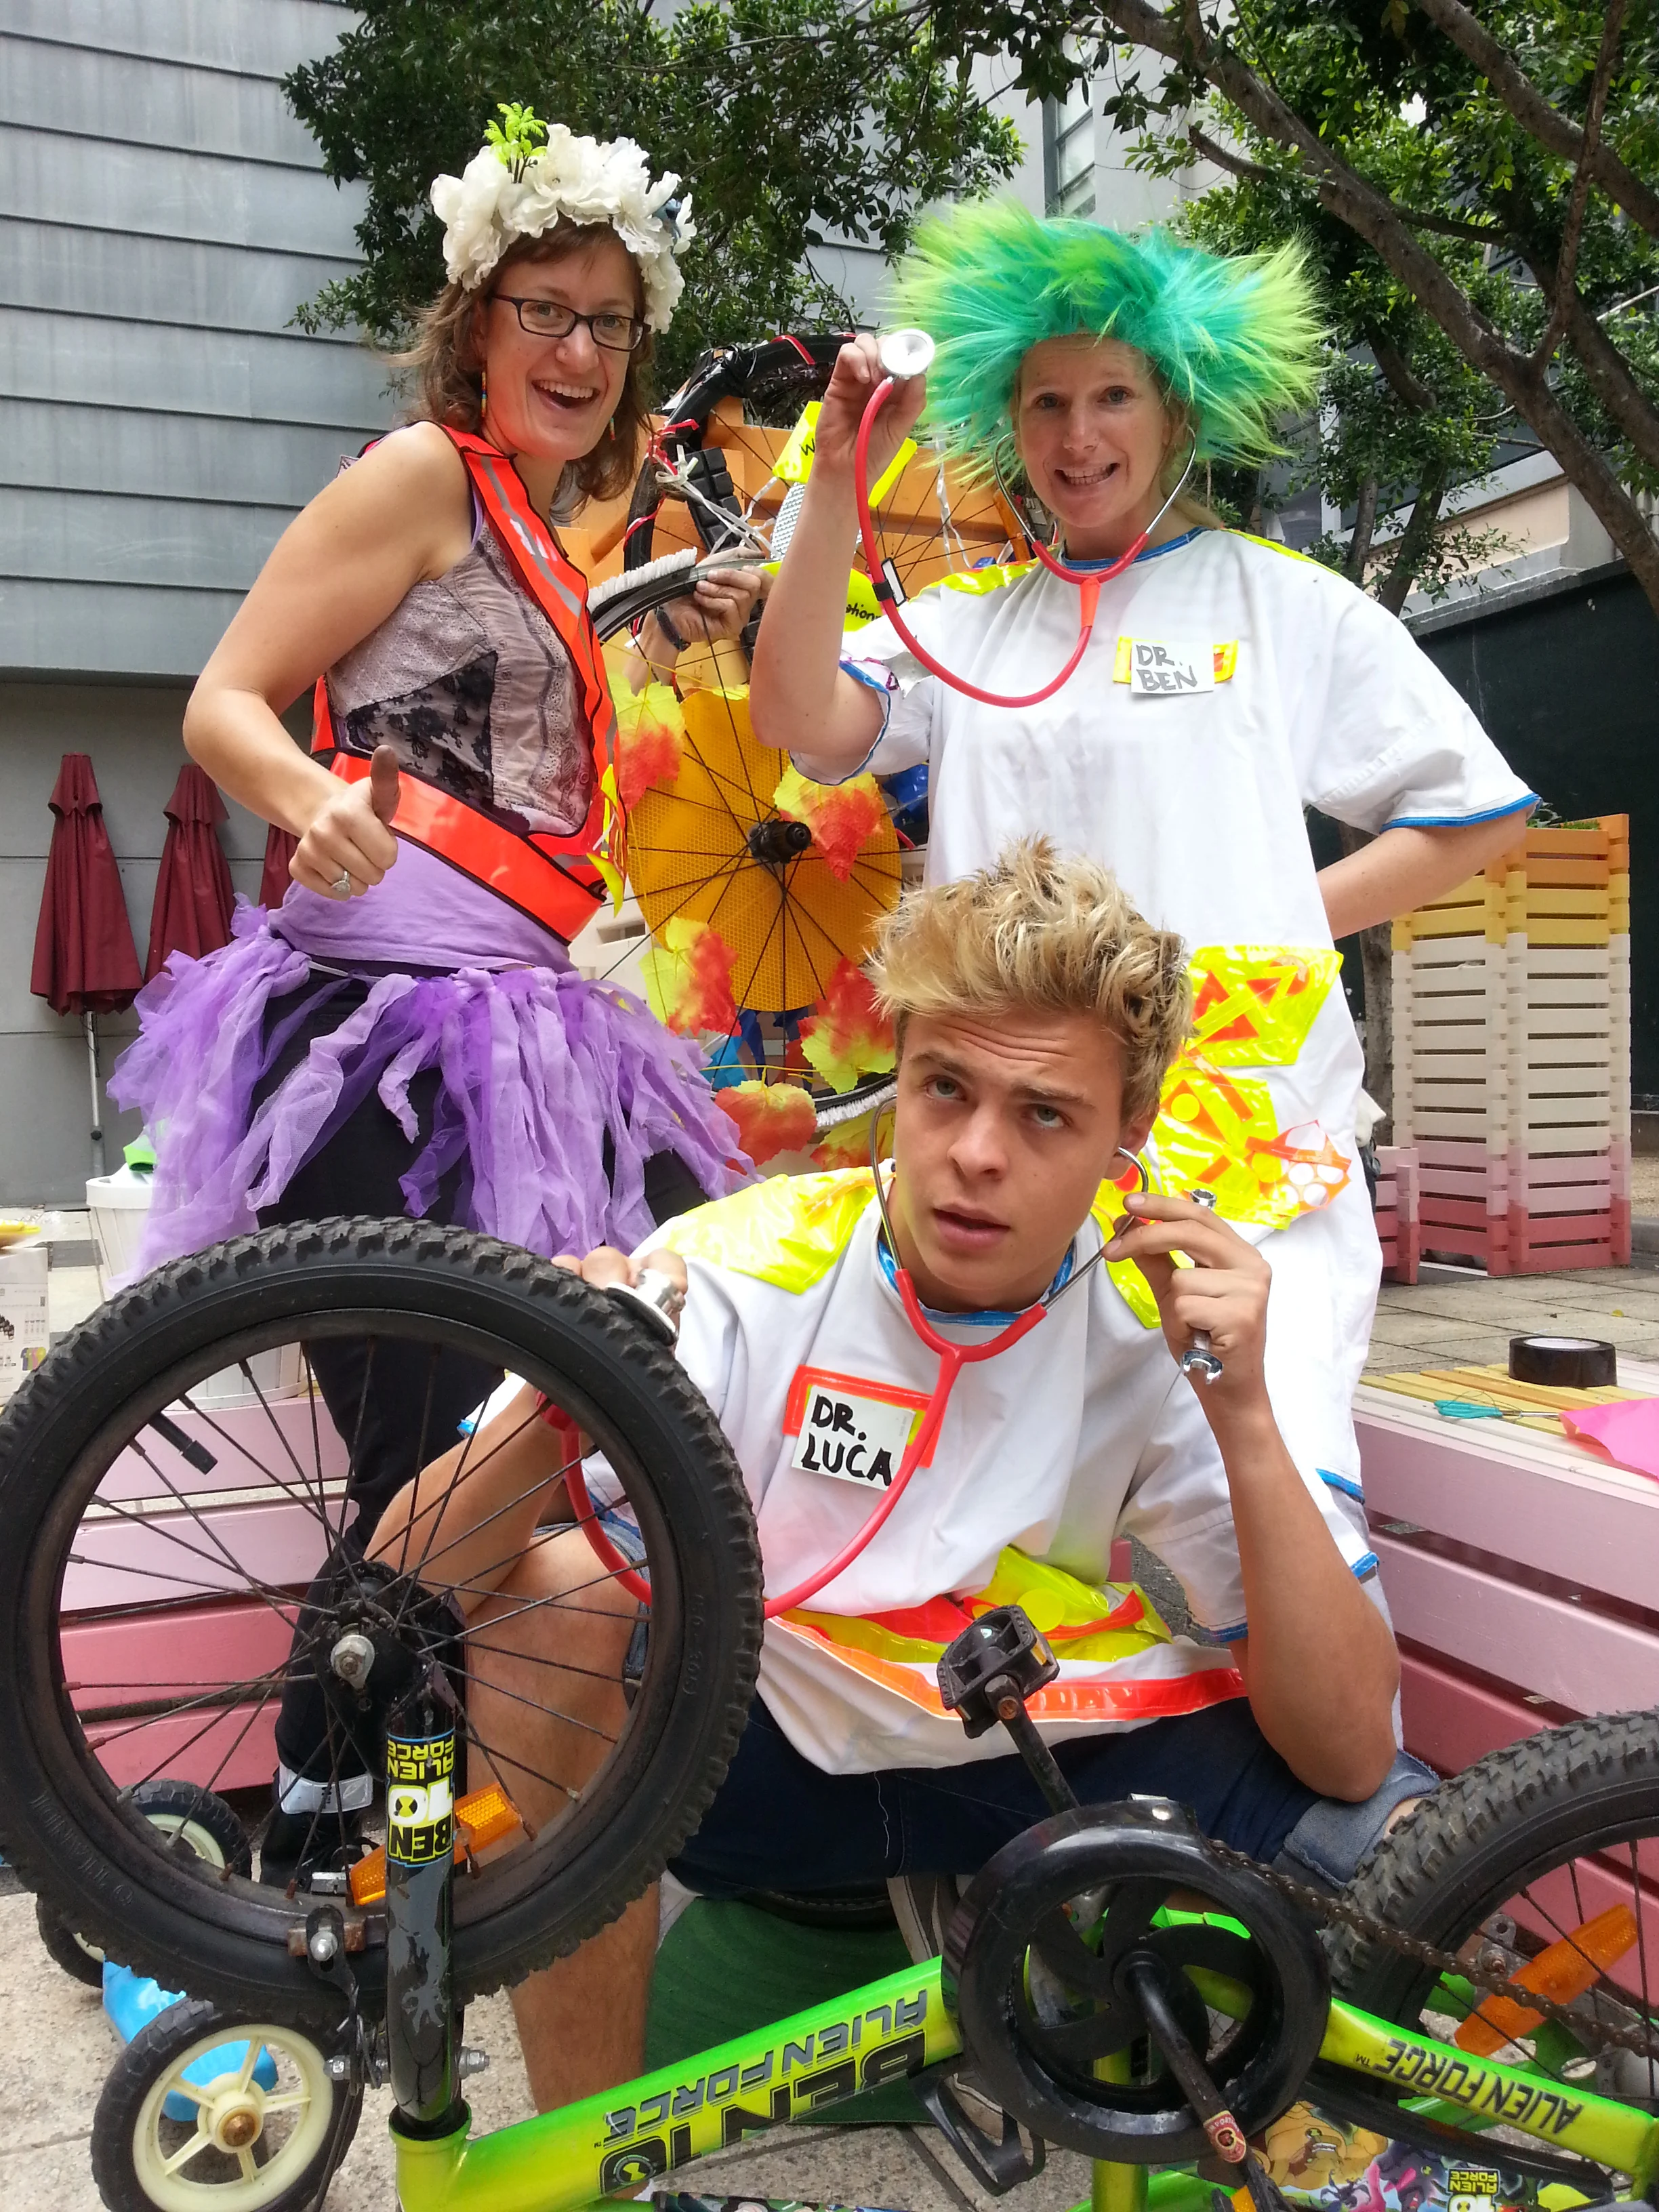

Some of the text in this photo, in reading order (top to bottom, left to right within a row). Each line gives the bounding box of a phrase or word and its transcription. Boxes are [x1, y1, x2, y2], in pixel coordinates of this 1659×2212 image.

[1136, 644, 1183, 666] DR.
[1136, 665, 1198, 691] BEN
[811, 1394, 867, 1441] DR.
[800, 1432, 893, 1486] LUCA
[387, 1735, 454, 1761] FORCE
[387, 1751, 454, 1780] ALIEN
[388, 1777, 453, 1826] 10
[388, 1818, 453, 1862] BEN
[781, 1988, 928, 2078] ALIEN
[1374, 2037, 1487, 2105] FORCE
[602, 2049, 775, 2150] FORCE
[1480, 2074, 1584, 2134] ALIEN
[1449, 2180, 1498, 2194] ALIEN
[1450, 2171, 1498, 2183] FORCE
